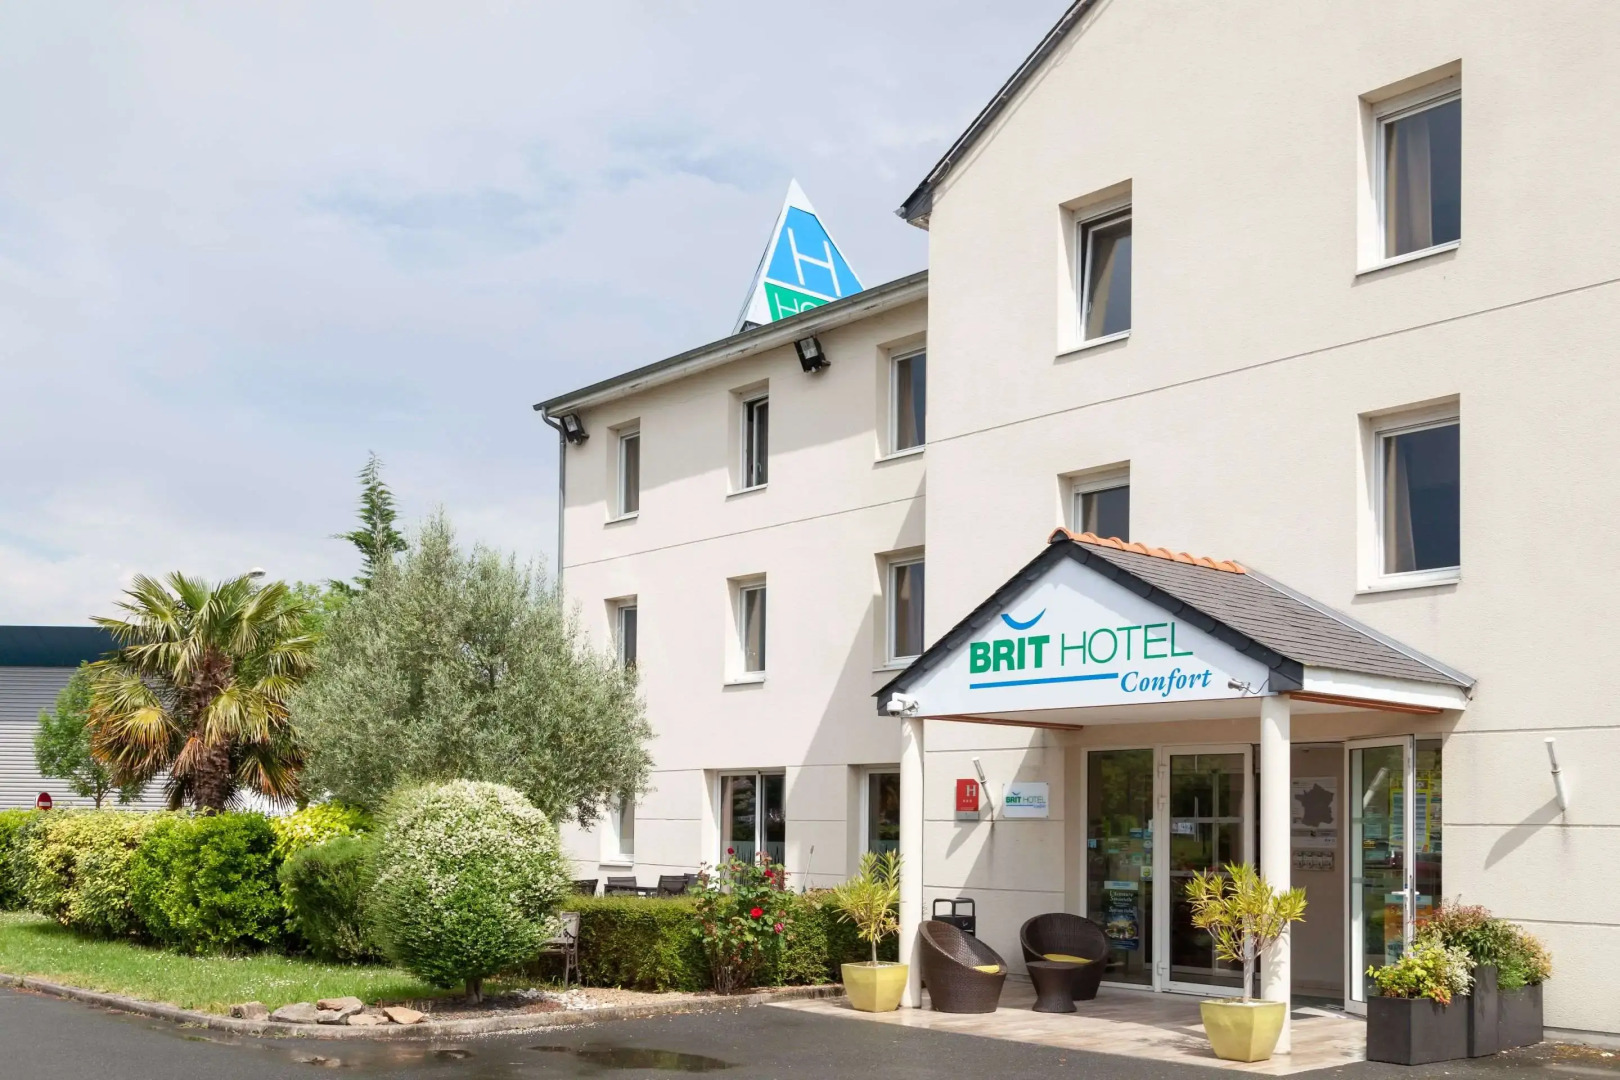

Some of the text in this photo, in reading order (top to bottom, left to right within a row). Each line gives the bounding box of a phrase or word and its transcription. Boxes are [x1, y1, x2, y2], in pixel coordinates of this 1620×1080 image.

[787, 227, 842, 297] H
[775, 292, 818, 319] H
[970, 622, 1193, 674] BRIT HOTEL
[1120, 667, 1212, 697] Confort
[966, 785, 976, 797] H
[1022, 795, 1046, 803] HOTEL
